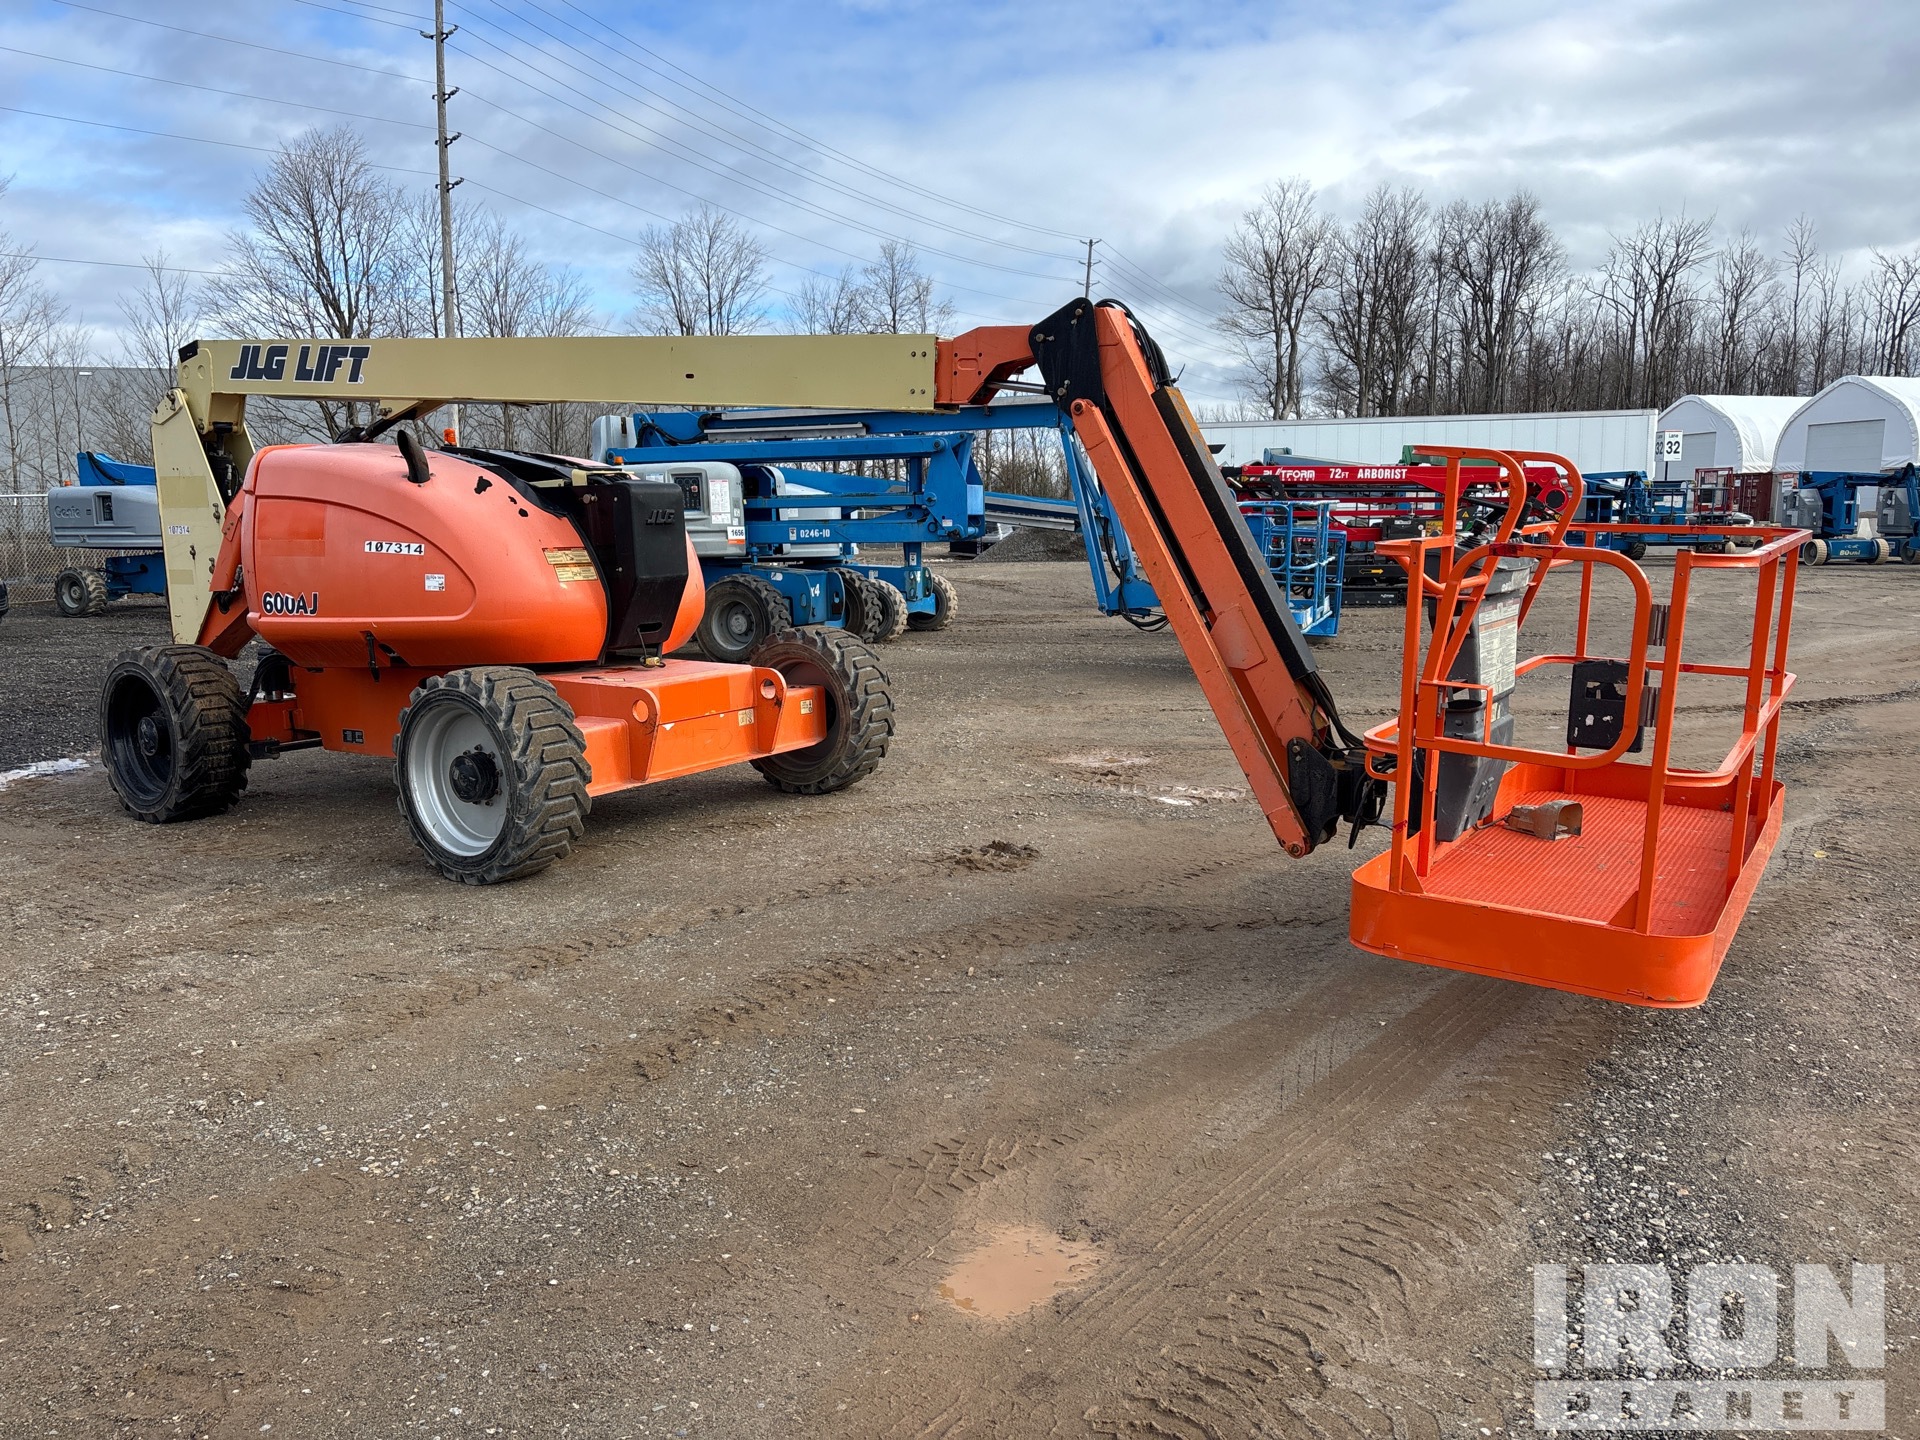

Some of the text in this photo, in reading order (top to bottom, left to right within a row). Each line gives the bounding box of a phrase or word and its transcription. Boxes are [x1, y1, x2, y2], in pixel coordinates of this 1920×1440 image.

[229, 344, 371, 384] JLG LIFT
[1666, 441, 1680, 454] 32
[1357, 468, 1407, 479] ARBORIST
[54, 505, 81, 518] Genie
[646, 508, 675, 525] JLG
[731, 529, 744, 537] 1656
[366, 541, 423, 555] 107314
[262, 591, 319, 616] 600AJ
